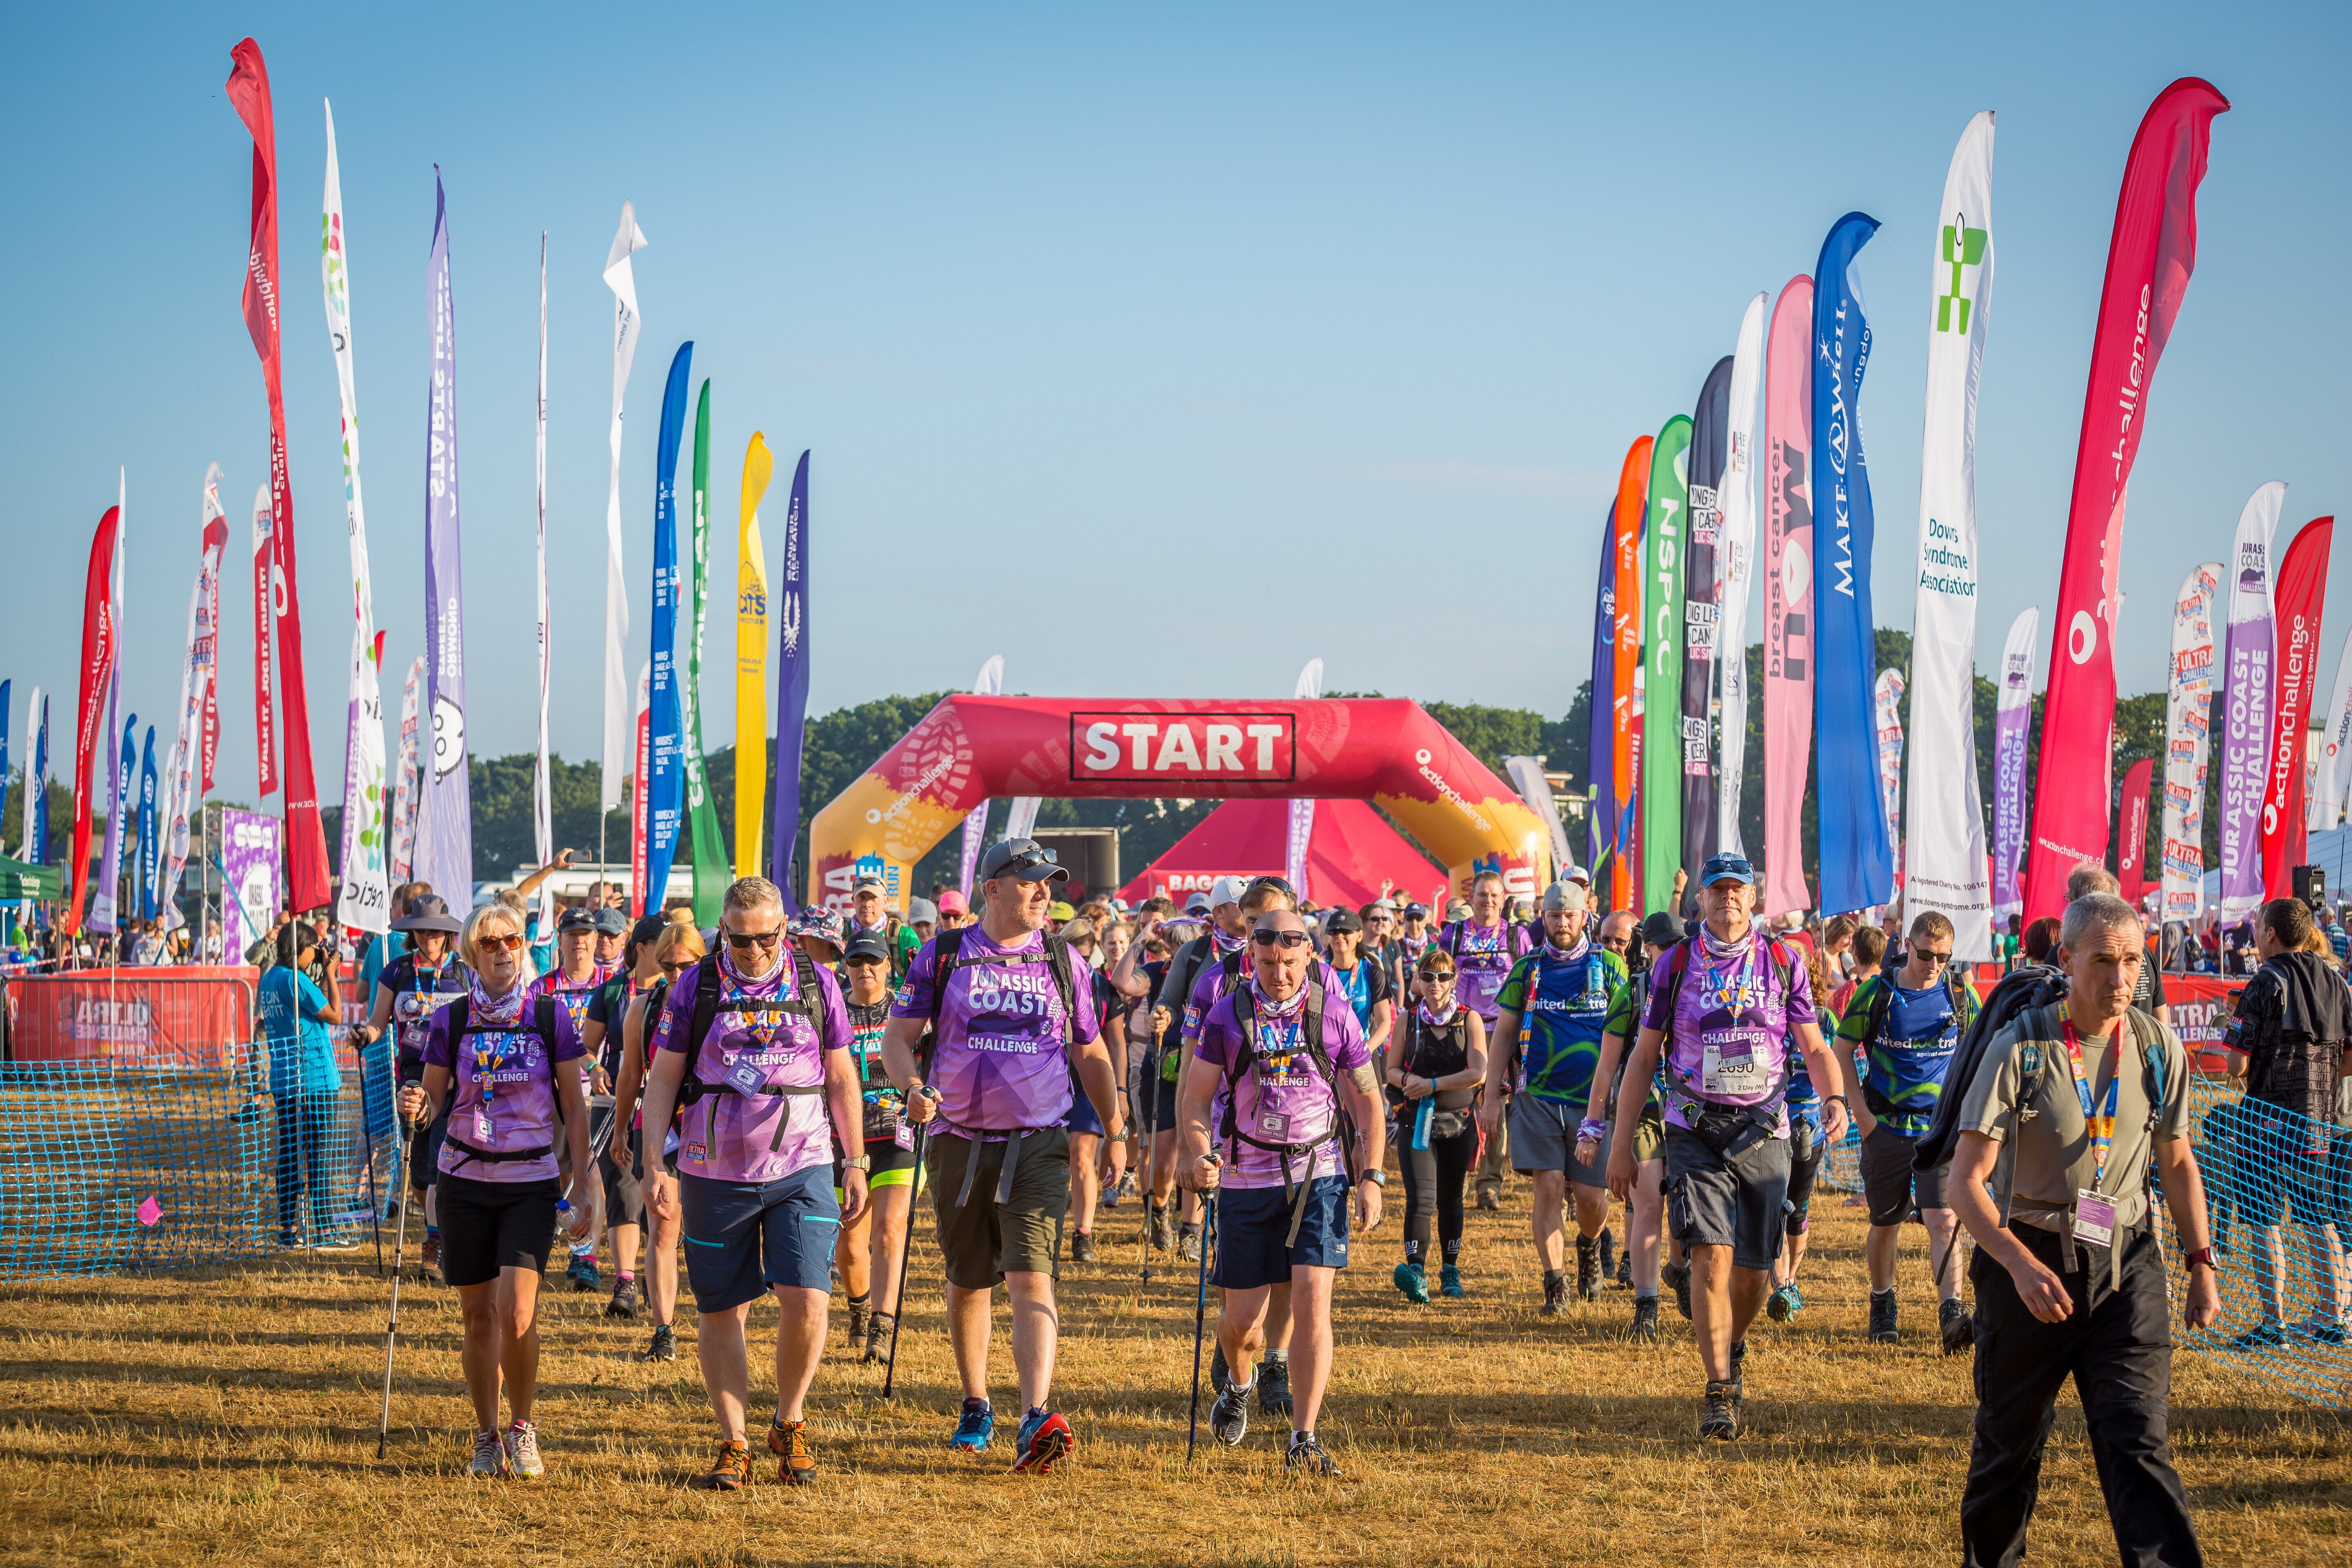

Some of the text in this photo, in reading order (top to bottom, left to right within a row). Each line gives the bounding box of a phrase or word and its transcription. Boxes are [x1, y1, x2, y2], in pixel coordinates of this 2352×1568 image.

[1769, 436, 1782, 677] breast cancer
[1924, 543, 1968, 570] Syndrome
[2241, 554, 2265, 568] COAS
[2242, 543, 2265, 555] JURASS
[1657, 497, 1679, 677] NSPCC
[2240, 583, 2266, 593] CHALLENG
[2232, 647, 2249, 737] COAST
[2275, 614, 2309, 809] actionchallenge
[1084, 722, 1283, 771] START
[2243, 648, 2268, 817] CHALLENGE
[2000, 727, 2014, 797] COAST
[883, 754, 956, 822] actionchallenge
[1418, 764, 1492, 833] actionchallenge
[2009, 727, 2024, 847] CHALLENGE
[2224, 746, 2245, 880] JURASSIC
[1997, 807, 2009, 891] JURASSIC
[2168, 841, 2202, 866] ULTRA
[1939, 880, 1953, 890] Charity
[971, 969, 1047, 993] JURASSIC
[968, 987, 1047, 1016] COAST
[2167, 1003, 2218, 1027] LTRA
[722, 1052, 796, 1066] CHALLENGE
[967, 1037, 1038, 1054] CHALLENGE
[2309, 1061, 2330, 1072] LONDON
[729, 1076, 753, 1094] EVENT PASS
